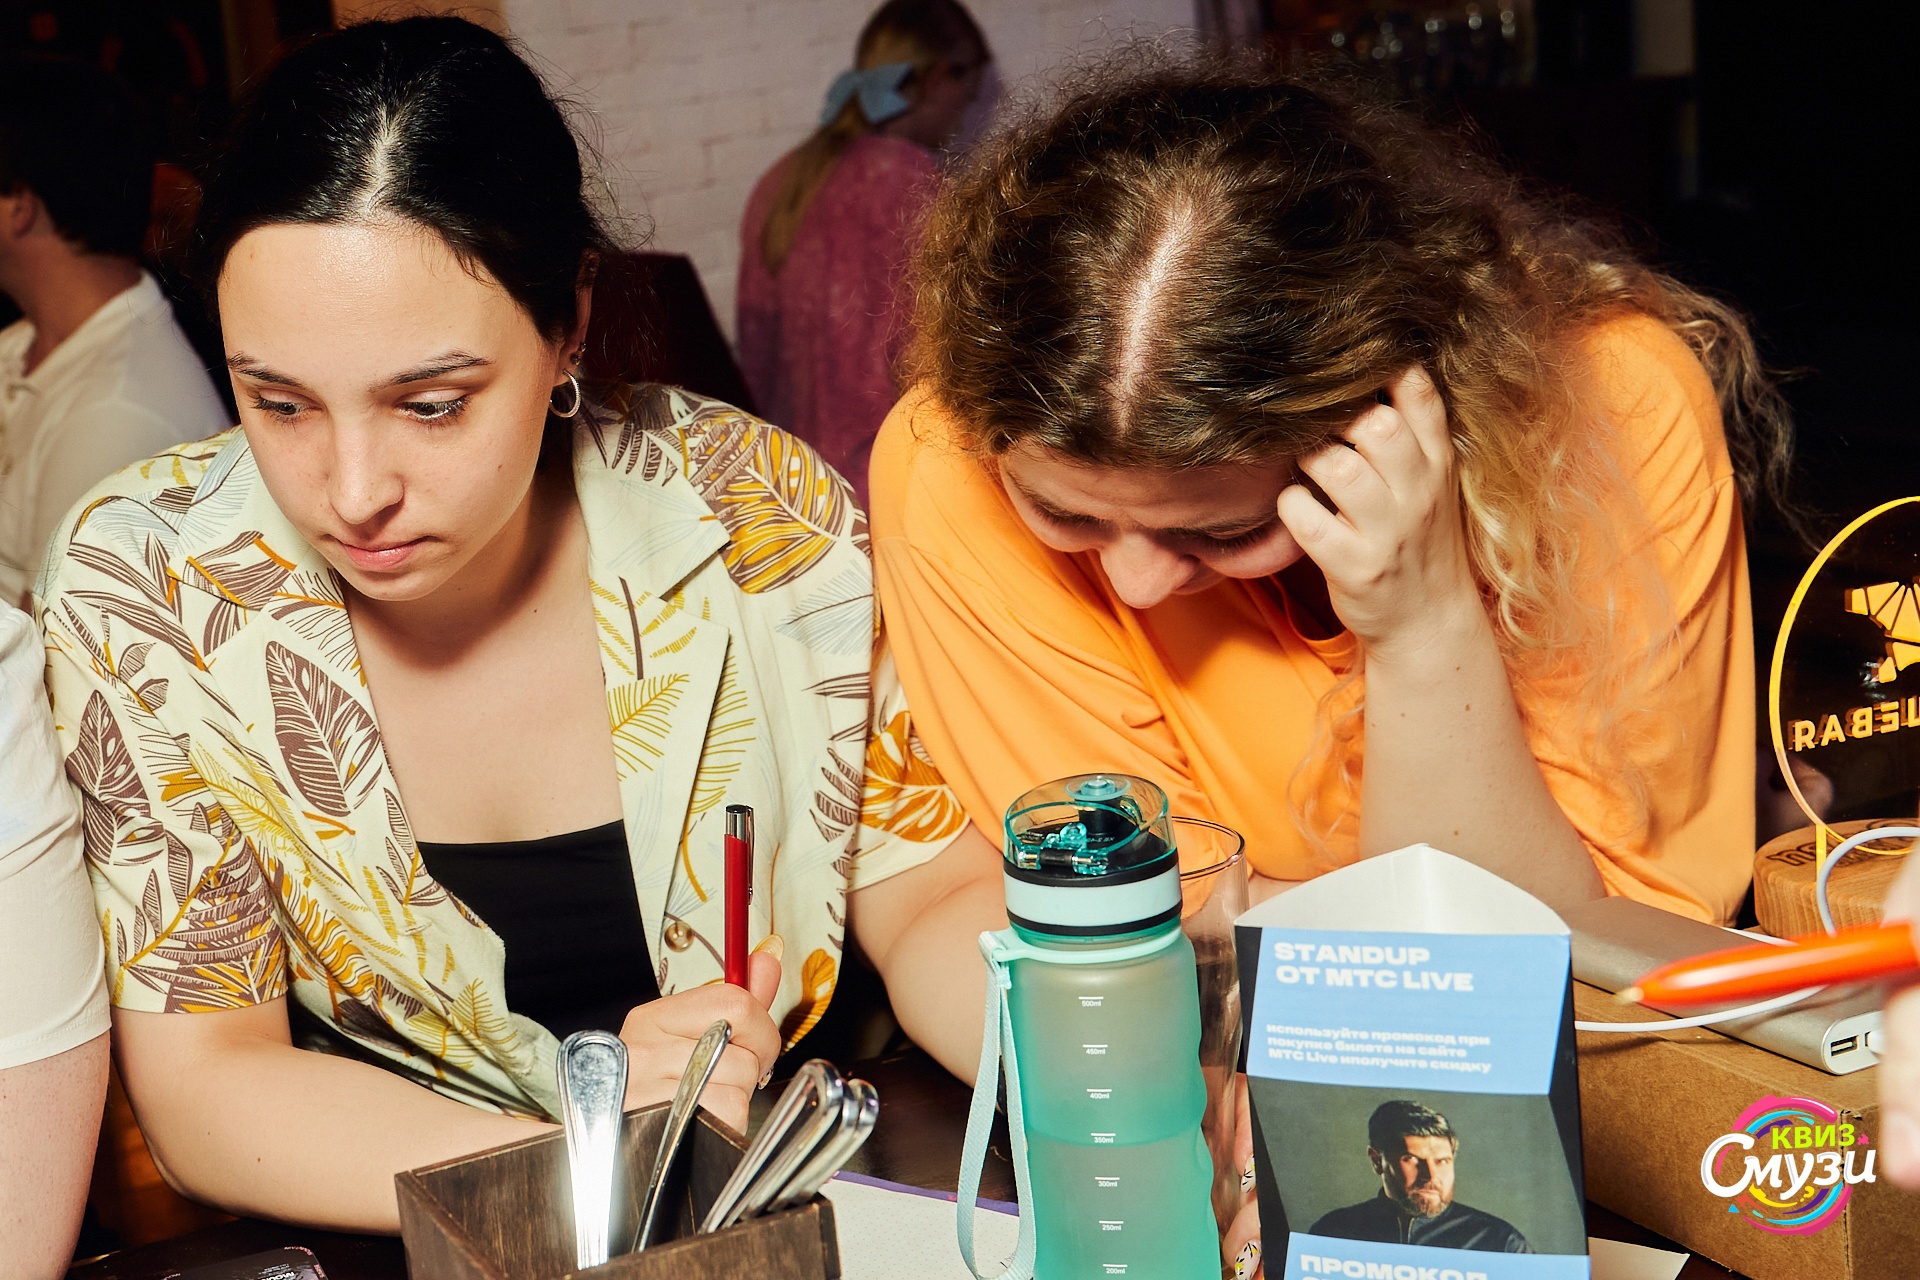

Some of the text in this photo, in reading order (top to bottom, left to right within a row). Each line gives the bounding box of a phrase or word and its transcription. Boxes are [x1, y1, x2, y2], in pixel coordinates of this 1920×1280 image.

[1274, 942, 1430, 966] STANDUP
[1402, 970, 1474, 992] LIVE
[1266, 1024, 1491, 1047] используйте промокод при
[1267, 1037, 1468, 1058] покупке билета на сайте
[1306, 1051, 1338, 1064] Live
[1429, 1060, 1492, 1074] скидку
